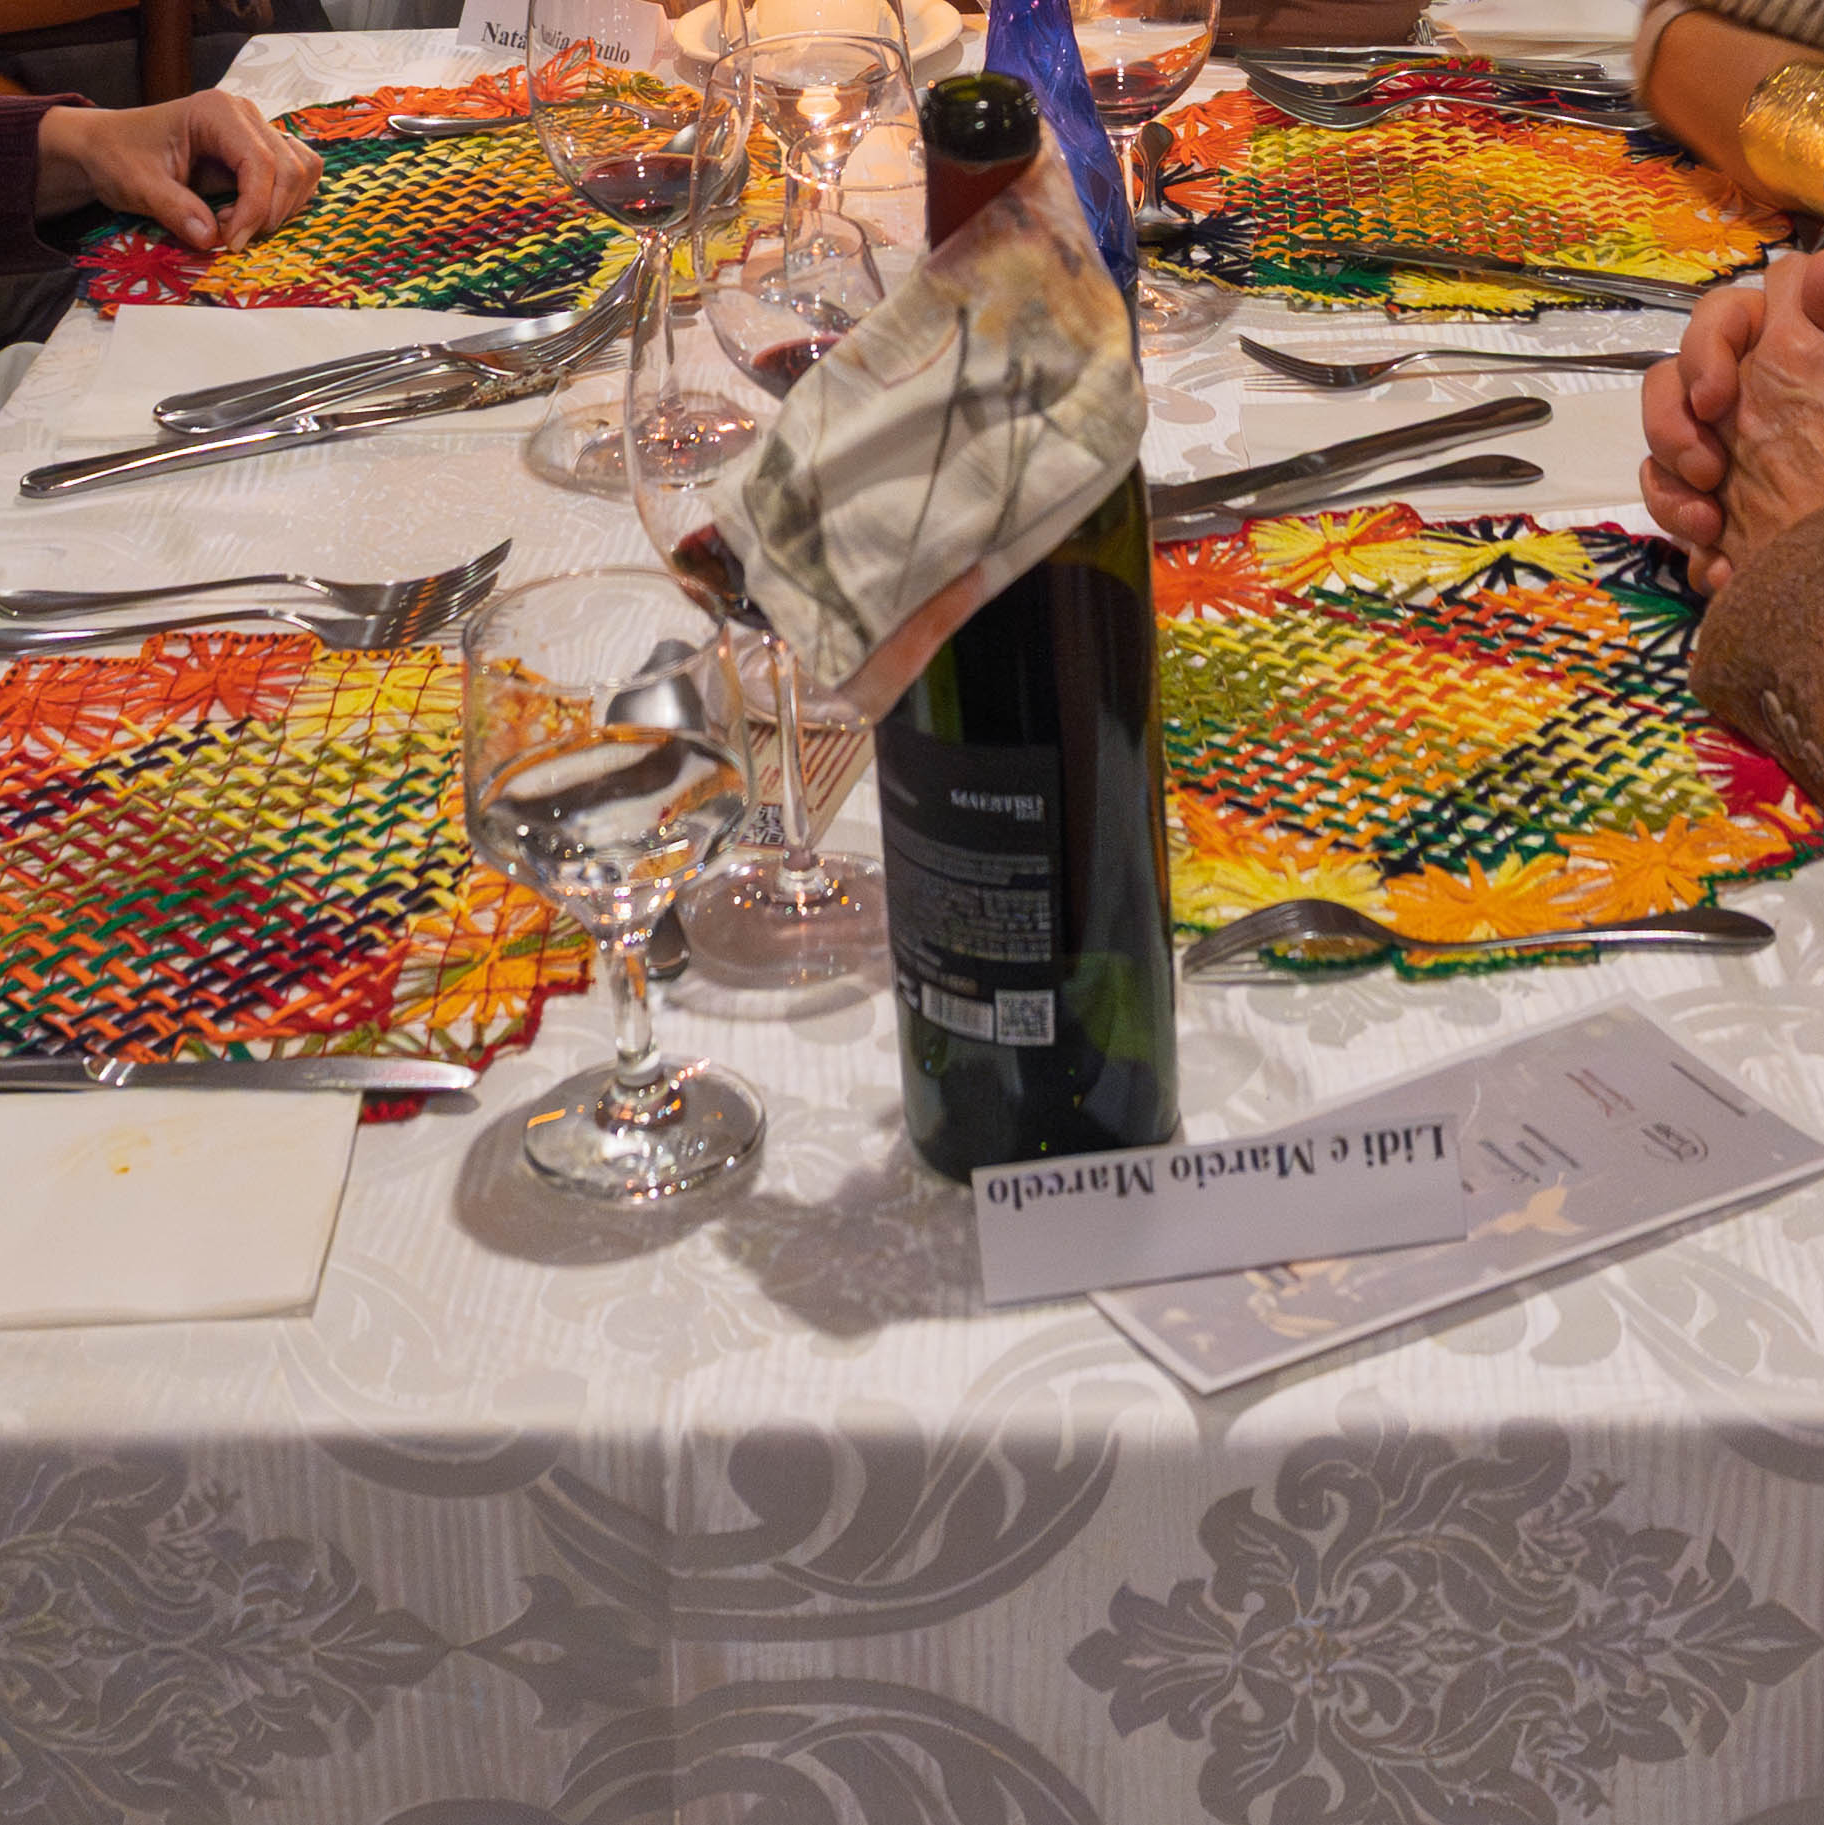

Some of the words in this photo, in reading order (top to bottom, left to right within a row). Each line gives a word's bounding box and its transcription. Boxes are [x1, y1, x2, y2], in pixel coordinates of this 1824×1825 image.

[1170, 1138, 1315, 1189] Marcio
[1330, 1133, 1349, 1163] e
[1363, 1124, 1445, 1168] Lidi
[987, 1157, 1155, 1212] Marcelo
